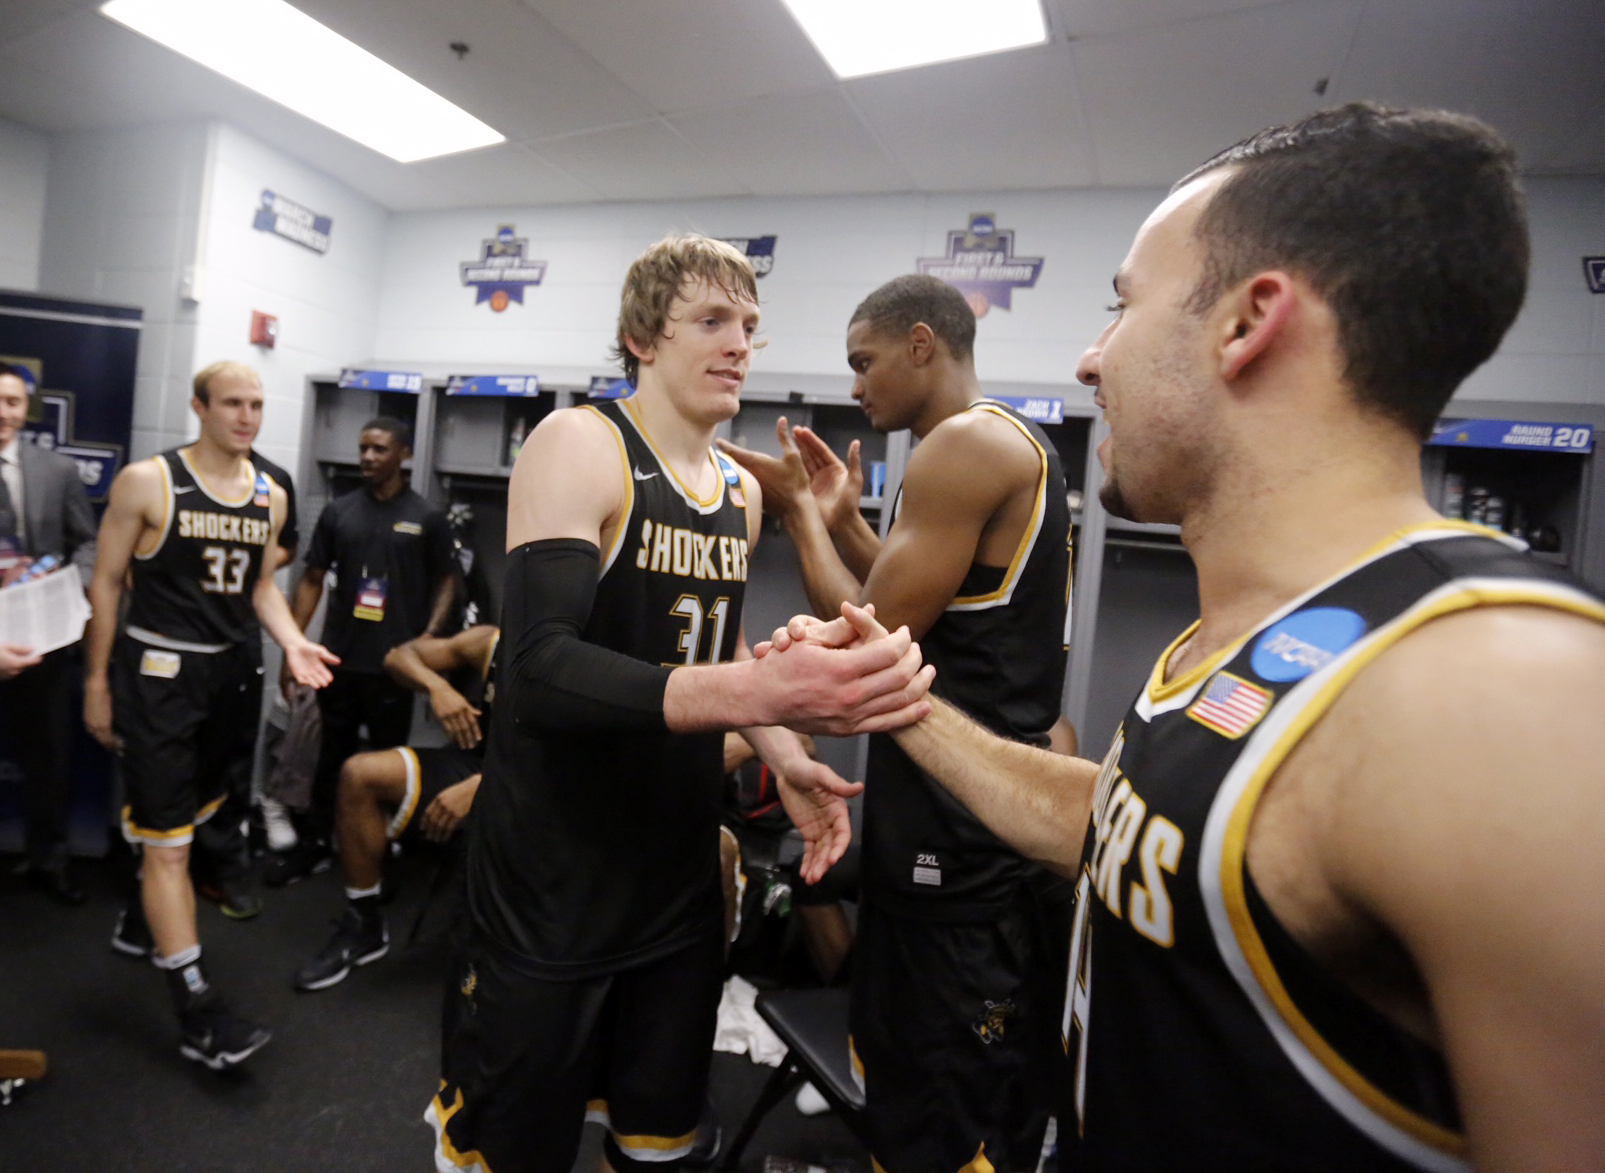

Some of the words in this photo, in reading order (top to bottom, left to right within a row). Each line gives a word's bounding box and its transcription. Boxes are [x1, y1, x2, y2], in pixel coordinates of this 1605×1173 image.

[1050, 400, 1062, 420] 1
[1552, 427, 1591, 447] 20
[178, 509, 270, 546] SHOCKERS
[635, 518, 749, 583] SHOCKERS
[201, 545, 251, 595] 33
[660, 593, 730, 668] 31
[916, 853, 940, 866] 2XL
